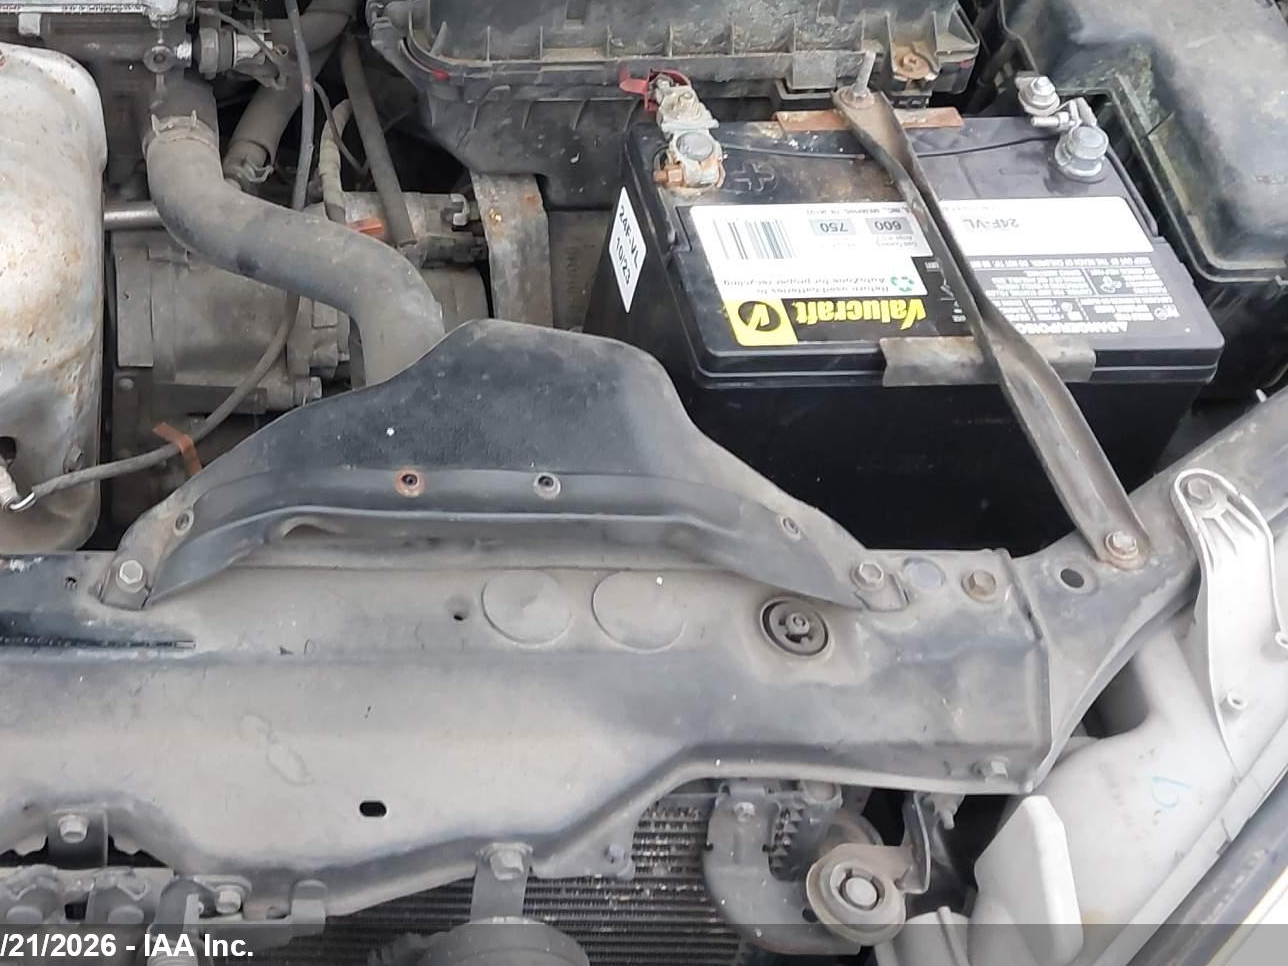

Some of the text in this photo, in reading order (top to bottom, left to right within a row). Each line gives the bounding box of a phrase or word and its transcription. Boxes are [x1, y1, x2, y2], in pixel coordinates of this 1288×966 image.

[819, 221, 849, 232] 750
[874, 220, 902, 233] 600
[962, 218, 1020, 230] 24F-VL
[618, 204, 641, 270] 24F-VL
[615, 237, 632, 285] 10/23
[795, 298, 927, 330] Valucraft
